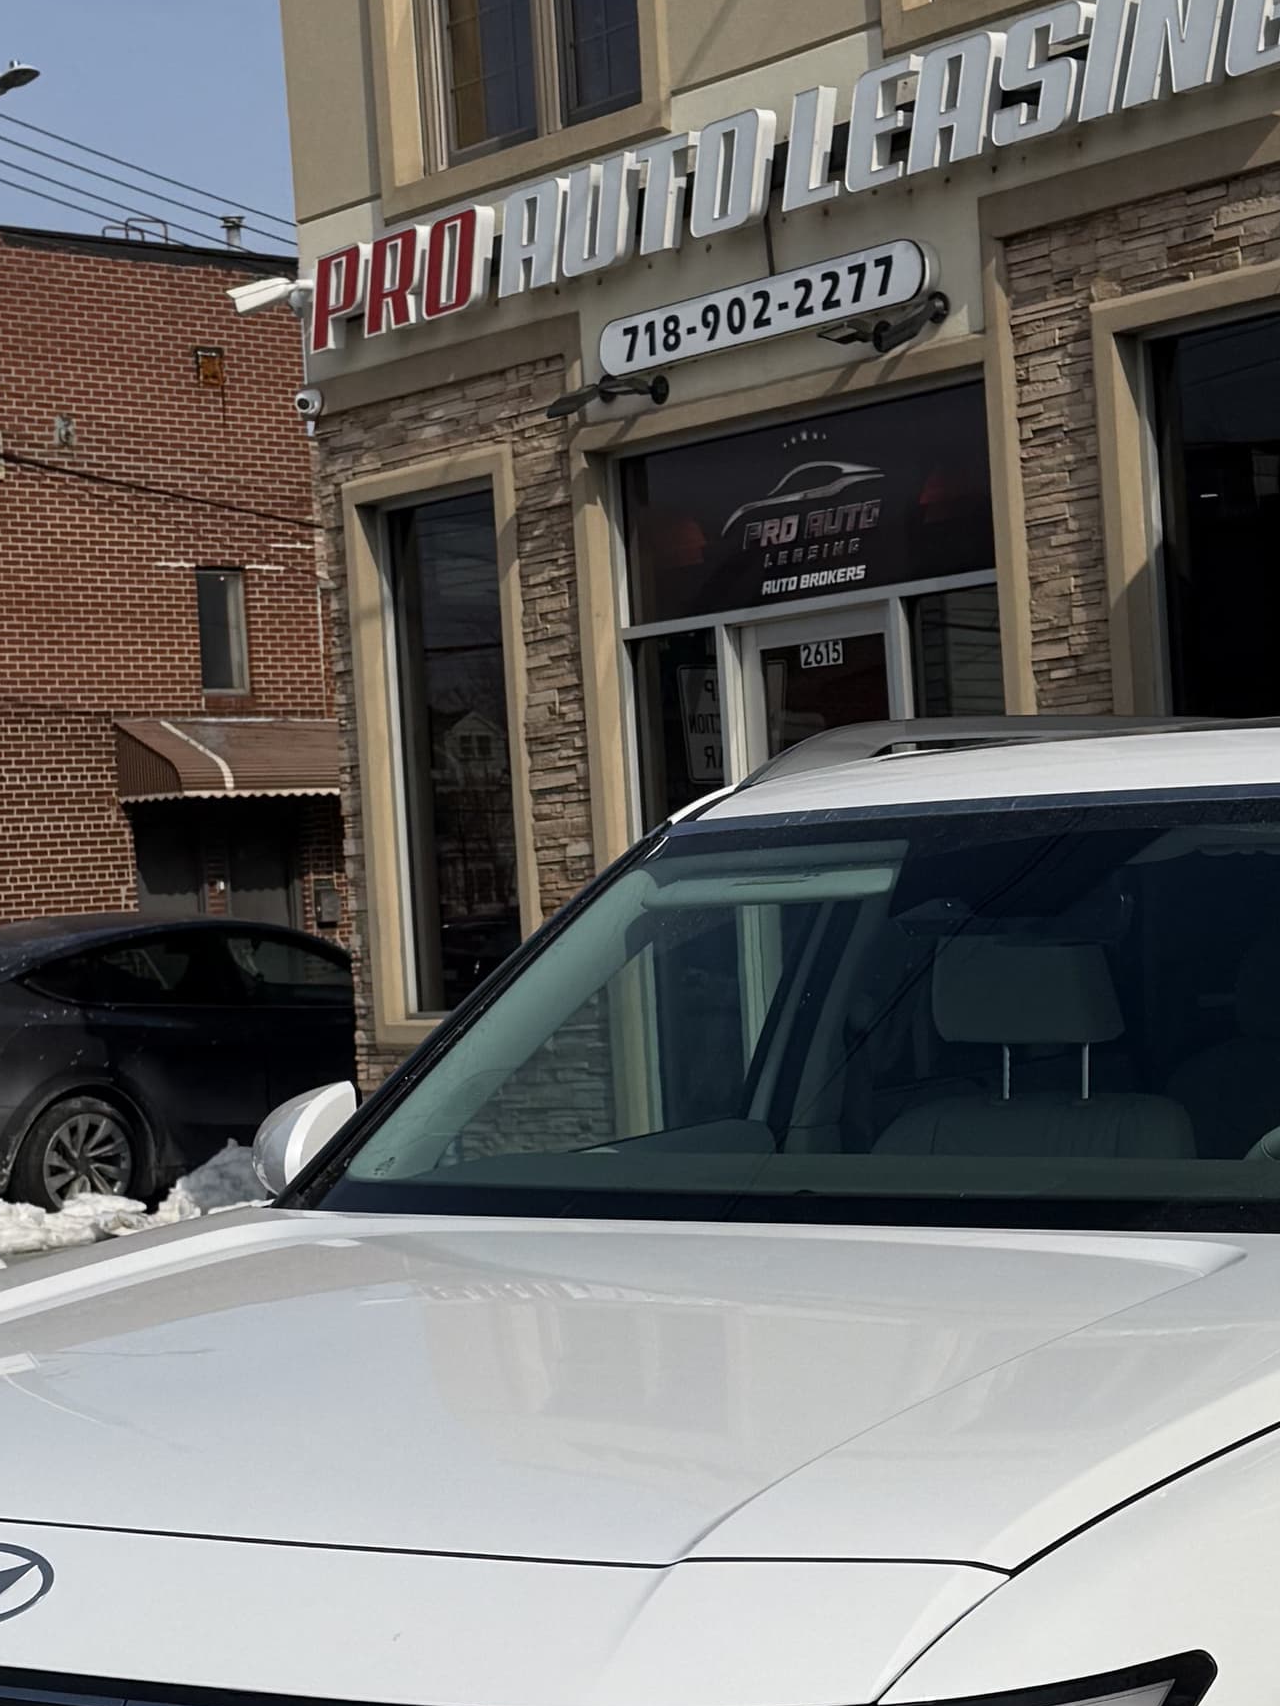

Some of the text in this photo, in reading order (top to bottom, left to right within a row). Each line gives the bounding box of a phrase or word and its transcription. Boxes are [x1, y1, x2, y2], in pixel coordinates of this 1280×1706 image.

[310, 205, 495, 355] PRO
[498, 108, 776, 299] AUTO
[622, 255, 894, 363] 718-902-2277
[743, 500, 882, 550] PRO AUTO
[762, 565, 866, 595] AUTO BROKERS
[802, 641, 841, 667] 2615
